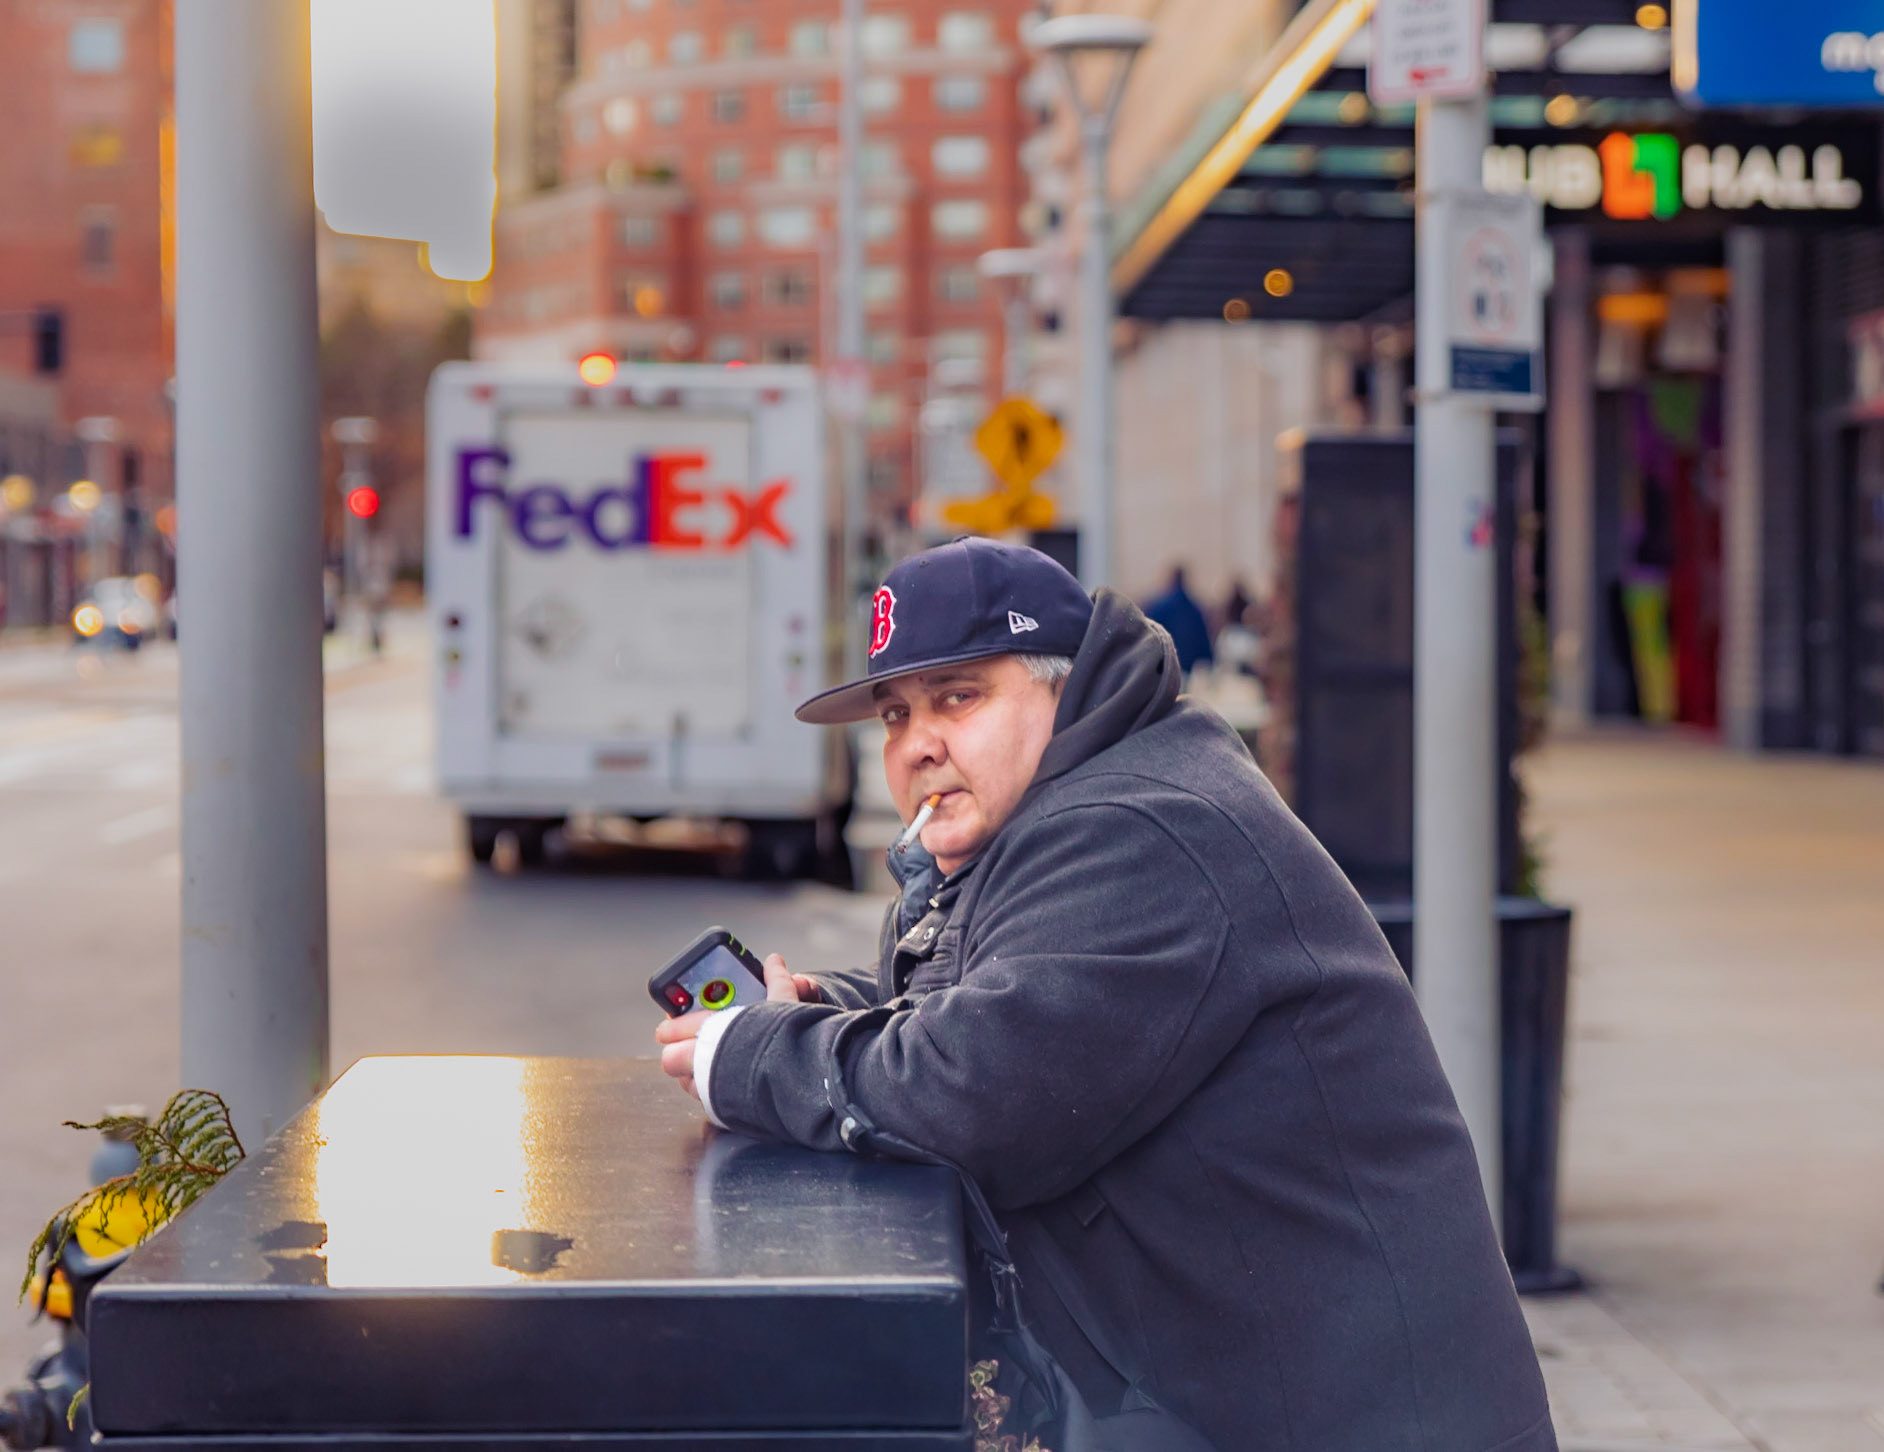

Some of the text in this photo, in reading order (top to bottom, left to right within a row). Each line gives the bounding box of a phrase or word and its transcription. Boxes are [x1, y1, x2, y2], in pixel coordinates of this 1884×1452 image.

[1682, 144, 1862, 209] HALL
[452, 445, 796, 553] FedEx
[869, 585, 897, 659] B
